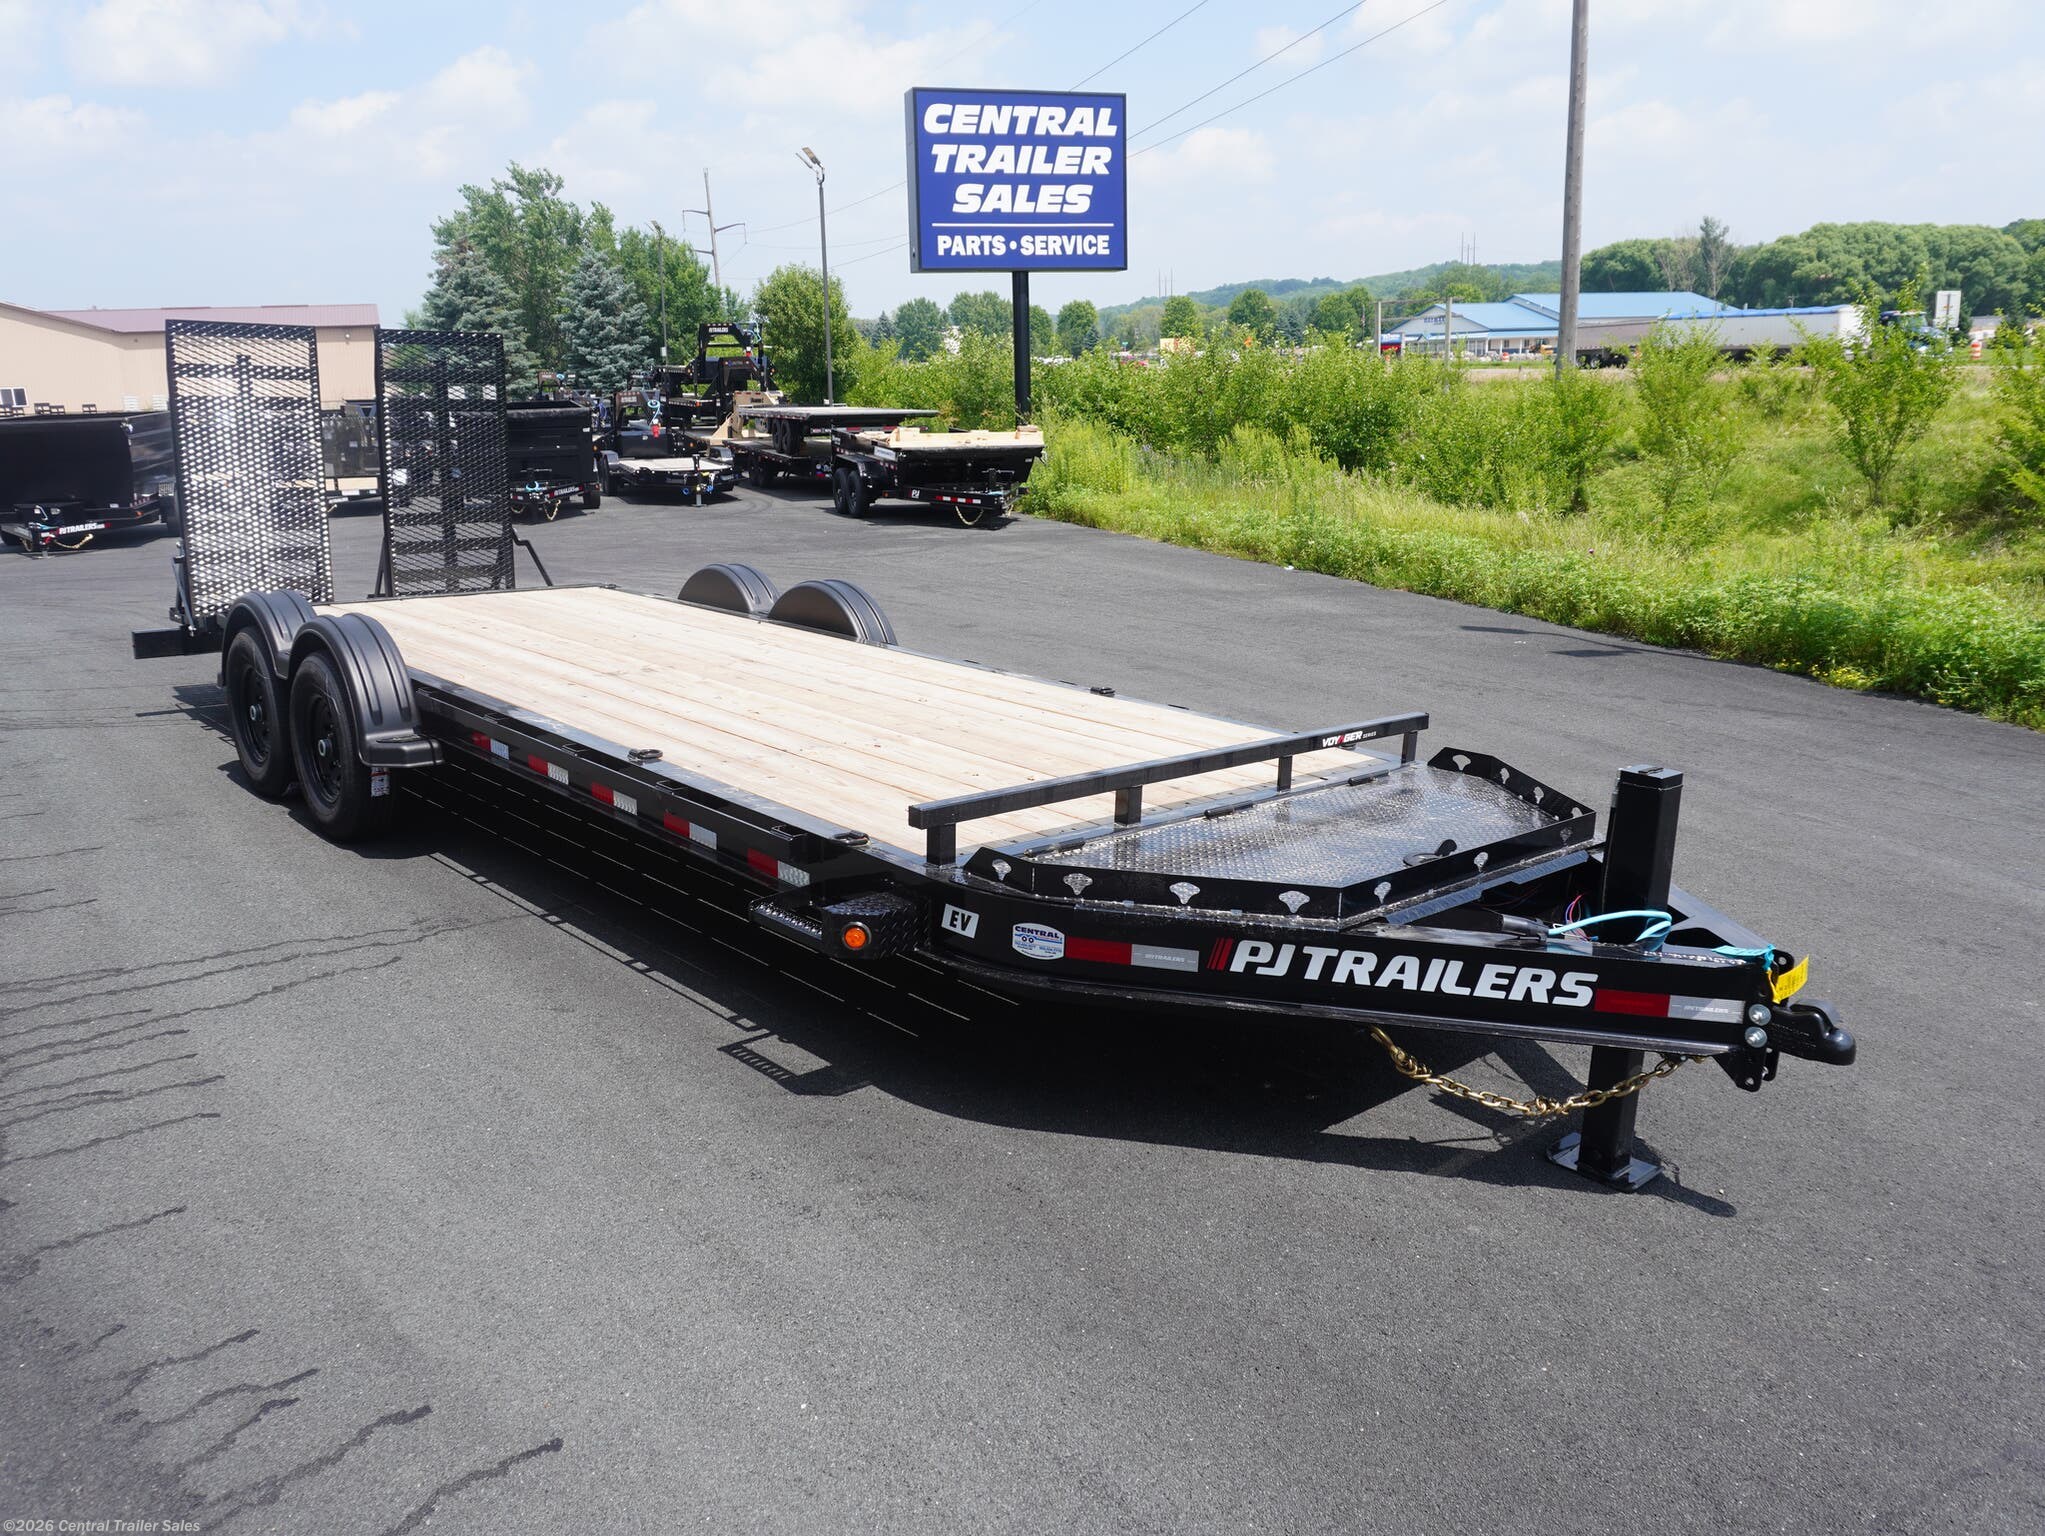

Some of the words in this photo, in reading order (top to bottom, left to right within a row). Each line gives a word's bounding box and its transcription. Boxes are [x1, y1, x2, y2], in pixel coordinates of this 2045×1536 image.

[923, 103, 1118, 137] CENTRAL
[931, 144, 1112, 175] TRAILER
[952, 183, 1094, 214] SALES
[937, 235, 1006, 256] PARTS
[1020, 235, 1110, 255] SERVICE
[949, 910, 972, 931] EV
[1015, 925, 1059, 939] CENTRAL
[1229, 939, 1296, 977] PJ
[1302, 946, 1599, 1007] TRAILERS
